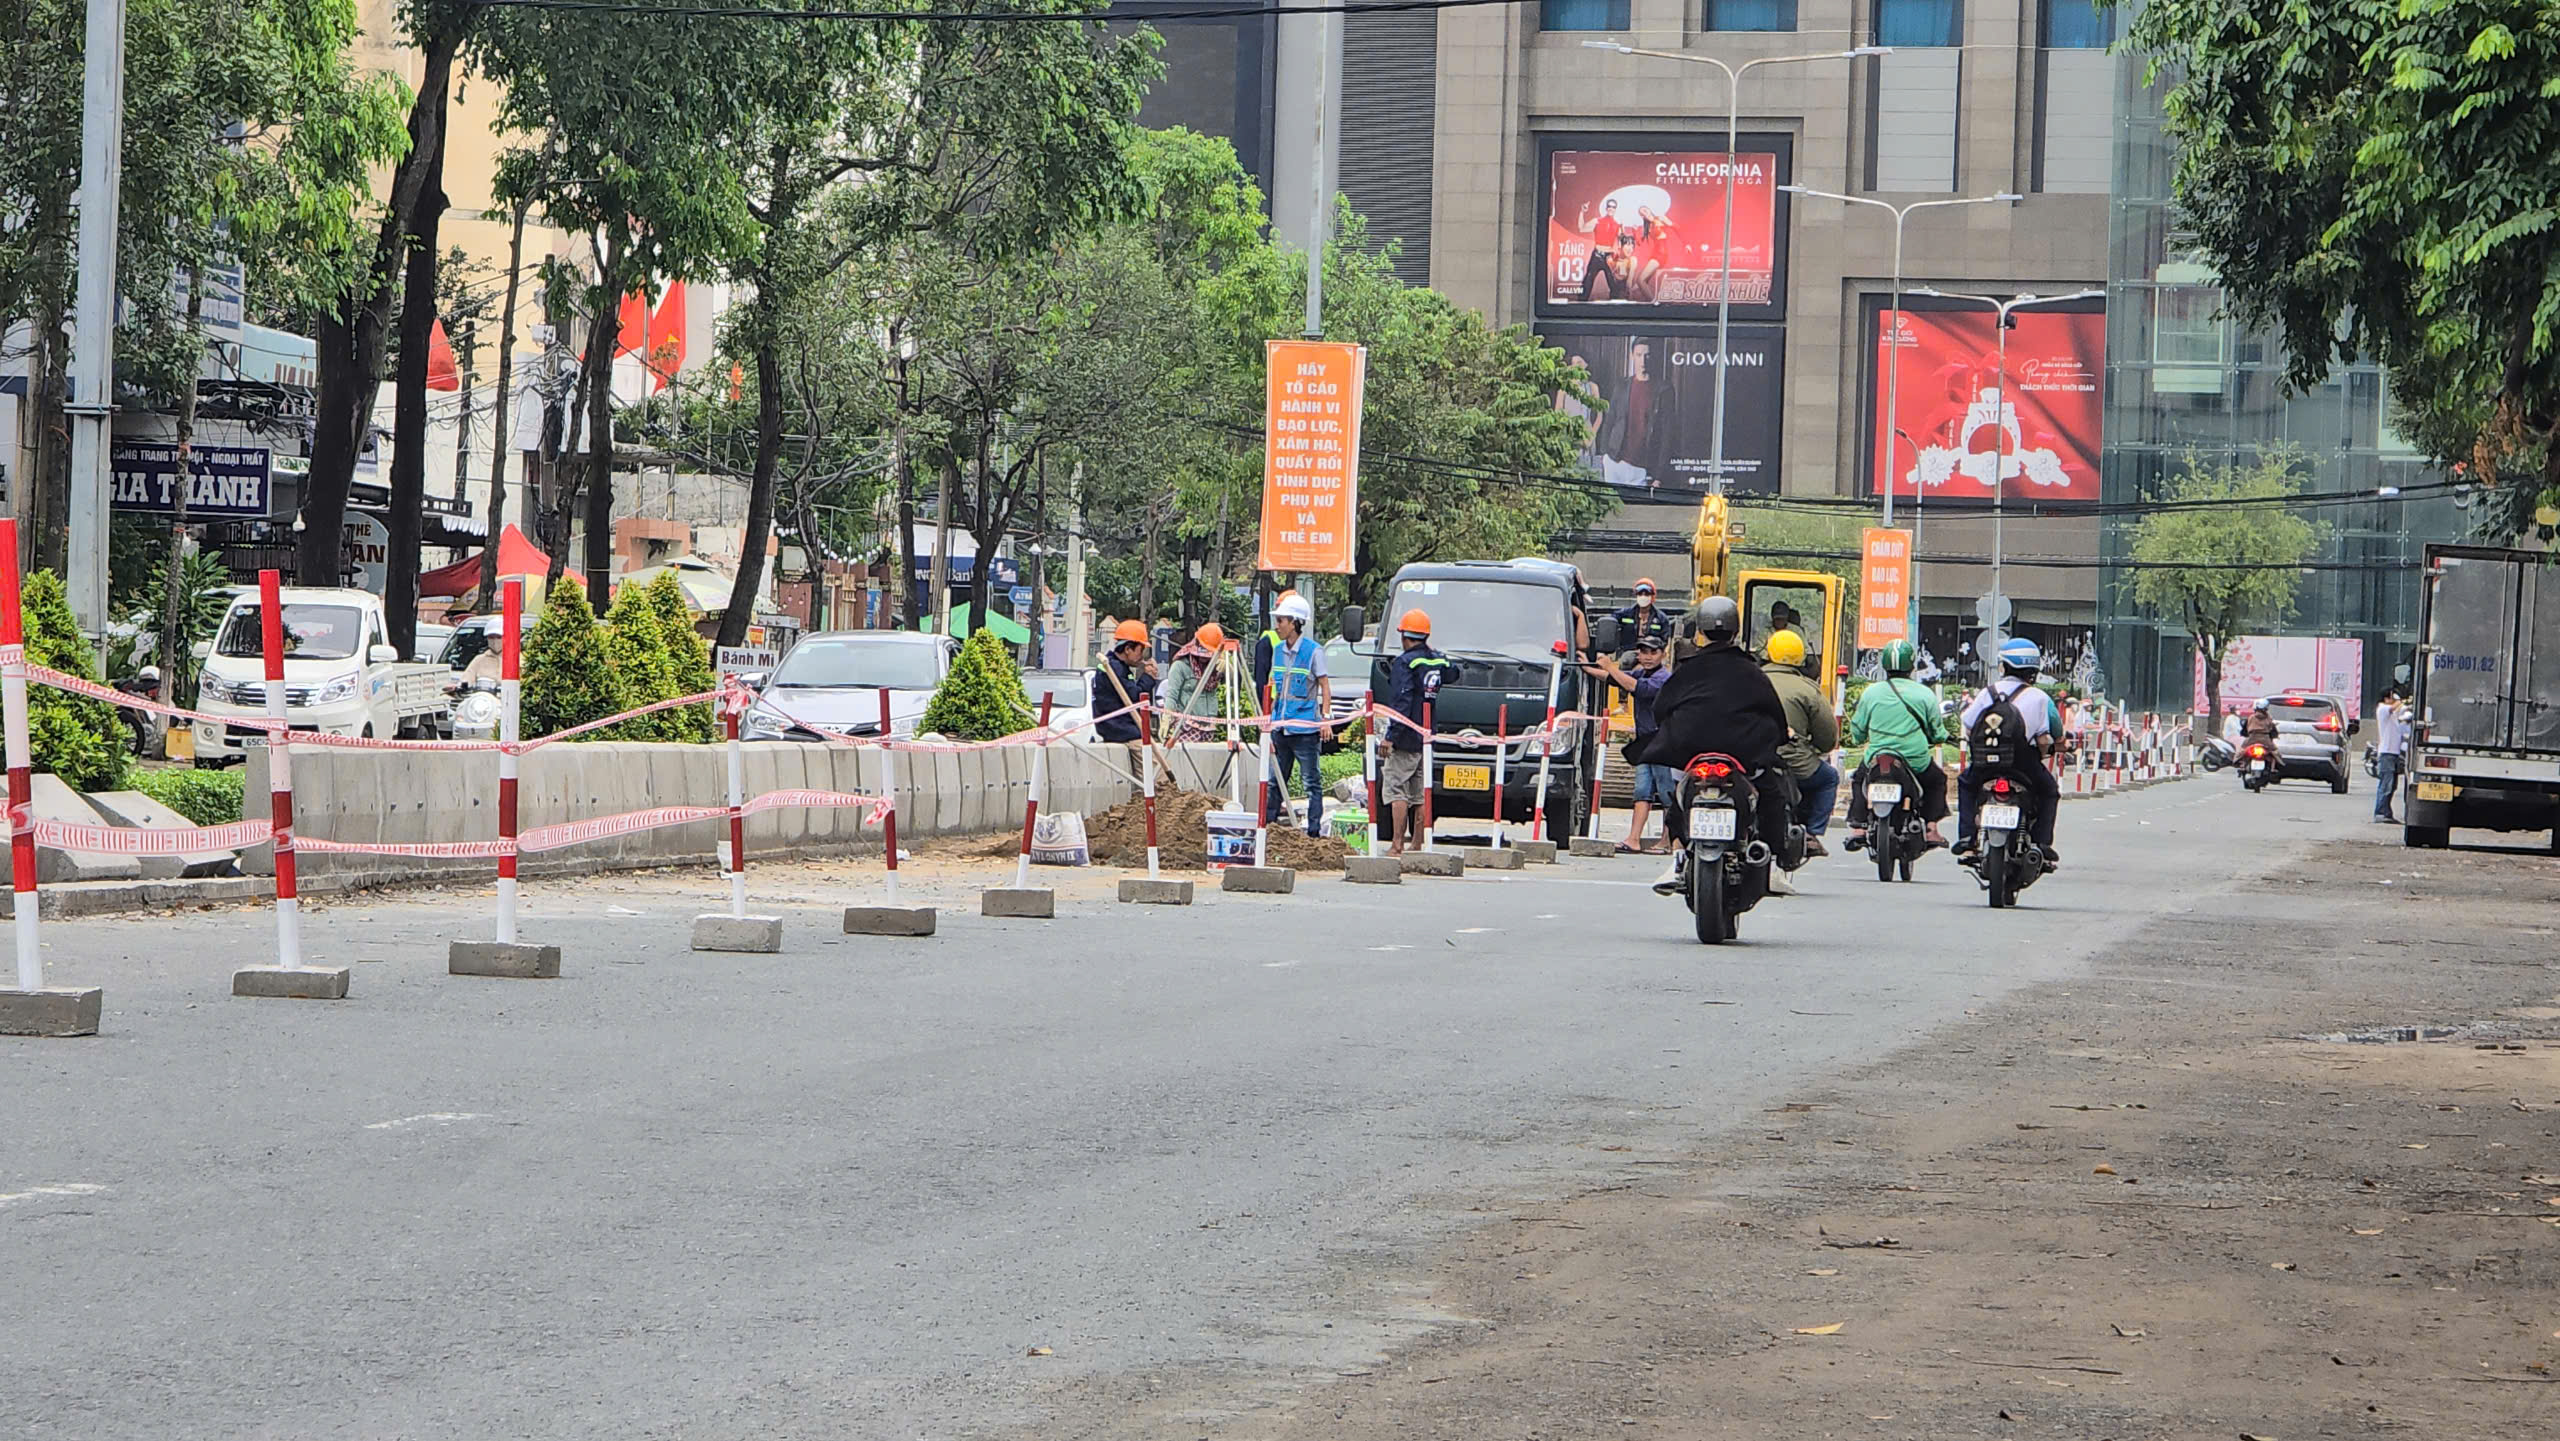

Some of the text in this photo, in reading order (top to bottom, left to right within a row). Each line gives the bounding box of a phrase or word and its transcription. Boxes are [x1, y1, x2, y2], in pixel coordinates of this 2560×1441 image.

[1655, 163, 1763, 177] CALIFORNIA
[1656, 177, 1708, 185] FITNESS
[1558, 257, 1584, 282] 03
[1285, 378, 1337, 395] TỐ CÁO
[1281, 398, 1340, 414] HÀNH VI
[1277, 418, 1343, 435] BẠO LỰC,
[1276, 436, 1342, 453] XÂM HẠI,
[140, 450, 169, 462] TRANG
[211, 453, 240, 467] NGOẠI
[242, 451, 264, 466] THẤT
[1276, 453, 1342, 470] QUẤY RỐI
[110, 466, 261, 507] GIA THÀNH
[1275, 472, 1342, 491] TÌNH DỤC
[1280, 493, 1310, 508] PHỤ
[1297, 510, 1317, 525] VÀ
[1309, 531, 1333, 544] EM
[722, 650, 754, 666] Bánh
[1457, 768, 1477, 778] 65H
[1448, 778, 1484, 788] 022.79
